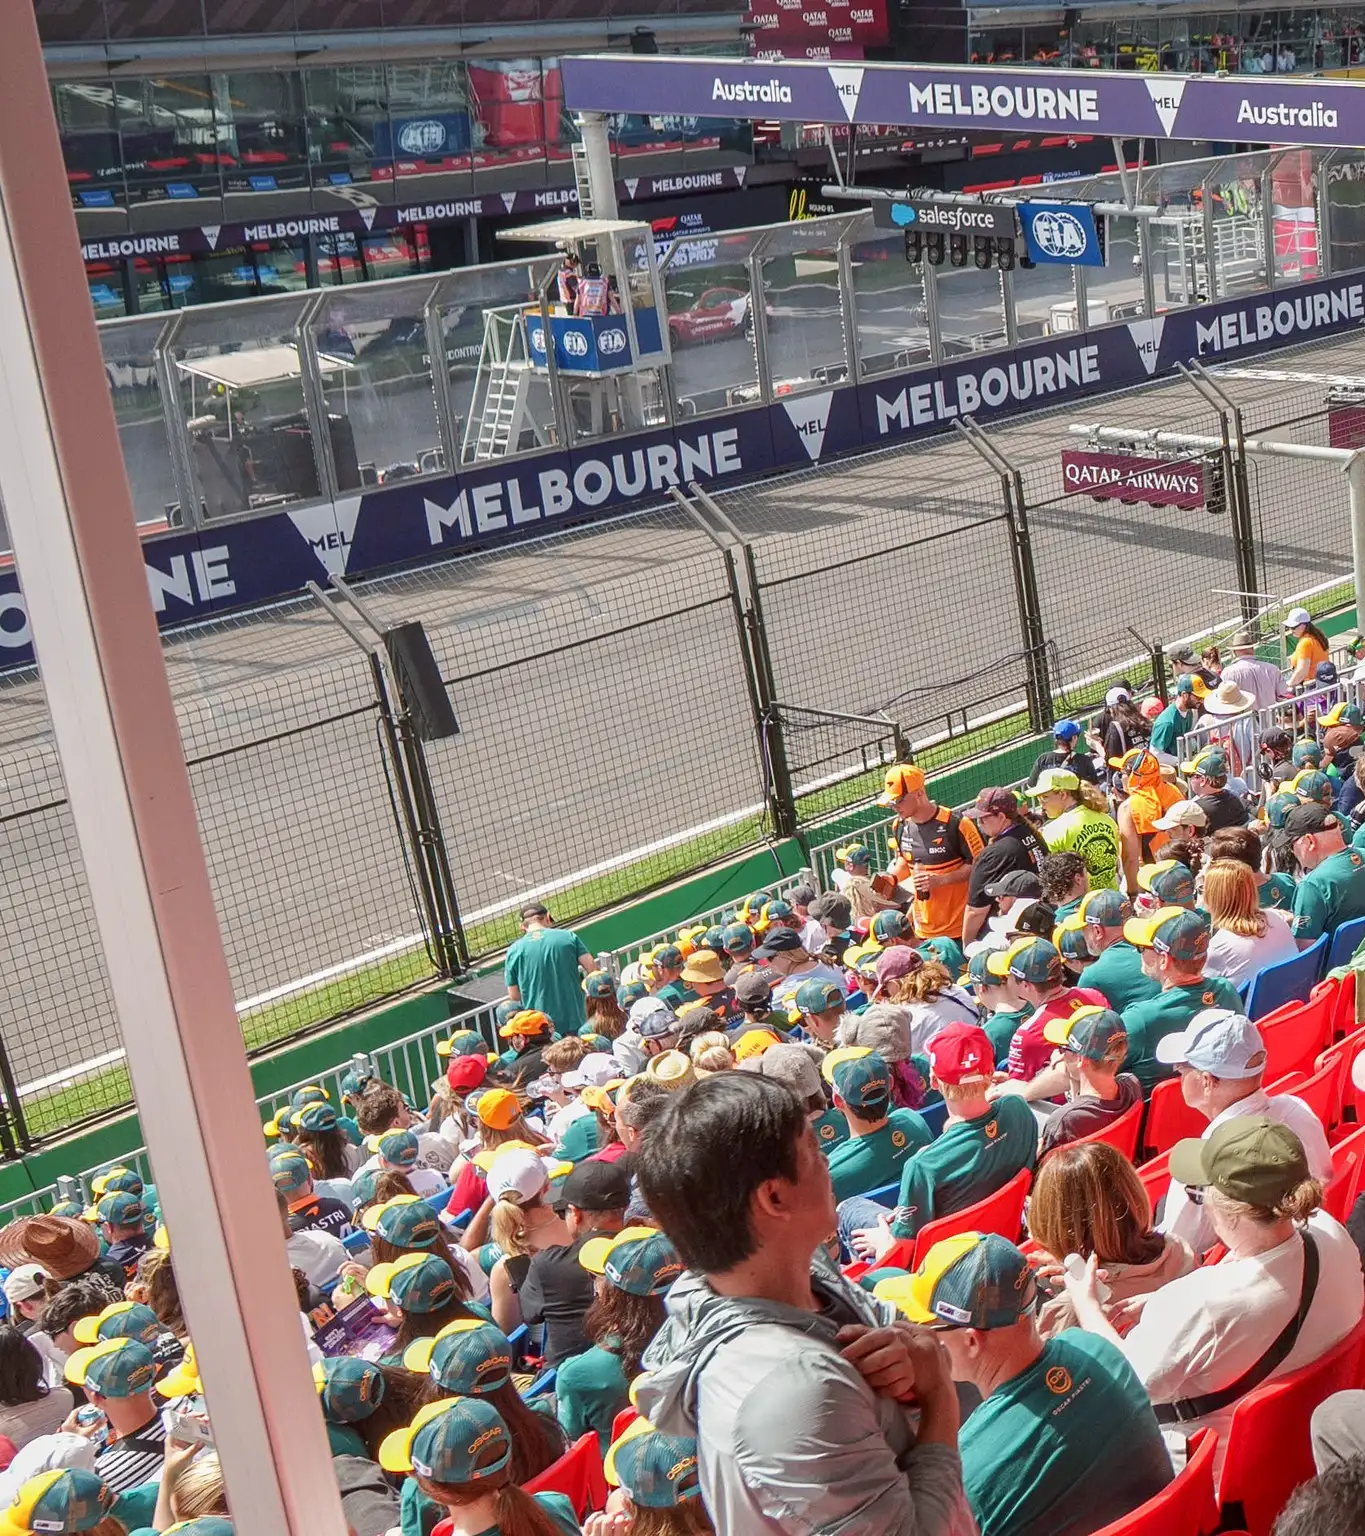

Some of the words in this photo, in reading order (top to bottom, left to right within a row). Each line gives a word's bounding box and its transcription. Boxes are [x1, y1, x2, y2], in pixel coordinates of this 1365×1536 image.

[753, 14, 778, 25] QATAR
[802, 11, 827, 22] QATAR
[850, 9, 873, 20] QATAR
[828, 28, 852, 39] QATAR
[806, 46, 830, 58] QATAR
[712, 78, 792, 103] Australia
[837, 84, 858, 96] MEL
[909, 82, 1099, 121] MELBOURNE
[1154, 98, 1178, 110] MEL
[1237, 100, 1338, 128] Australia
[652, 173, 723, 194] MELBOURNE
[535, 189, 578, 207] MELBO
[397, 200, 482, 224] MELBOURNE
[919, 205, 994, 232] salesforce
[244, 216, 339, 242] MELBOURNE
[1036, 222, 1083, 247] FIA
[689, 247, 717, 263] PRIX
[1196, 284, 1365, 355] MELBOURNE
[566, 336, 586, 351] FIA
[600, 334, 624, 348] FIA
[1137, 338, 1159, 356] MEL
[876, 344, 1100, 436] MELBOURNE
[796, 419, 825, 437] MEL
[424, 428, 743, 546] MELBOURNE
[1066, 463, 1121, 486] QATAR
[1125, 469, 1199, 495] AIRWAYS
[308, 530, 353, 552] MEL
[476, 1354, 510, 1373] OSCAR
[468, 1426, 502, 1454] OSCAR
